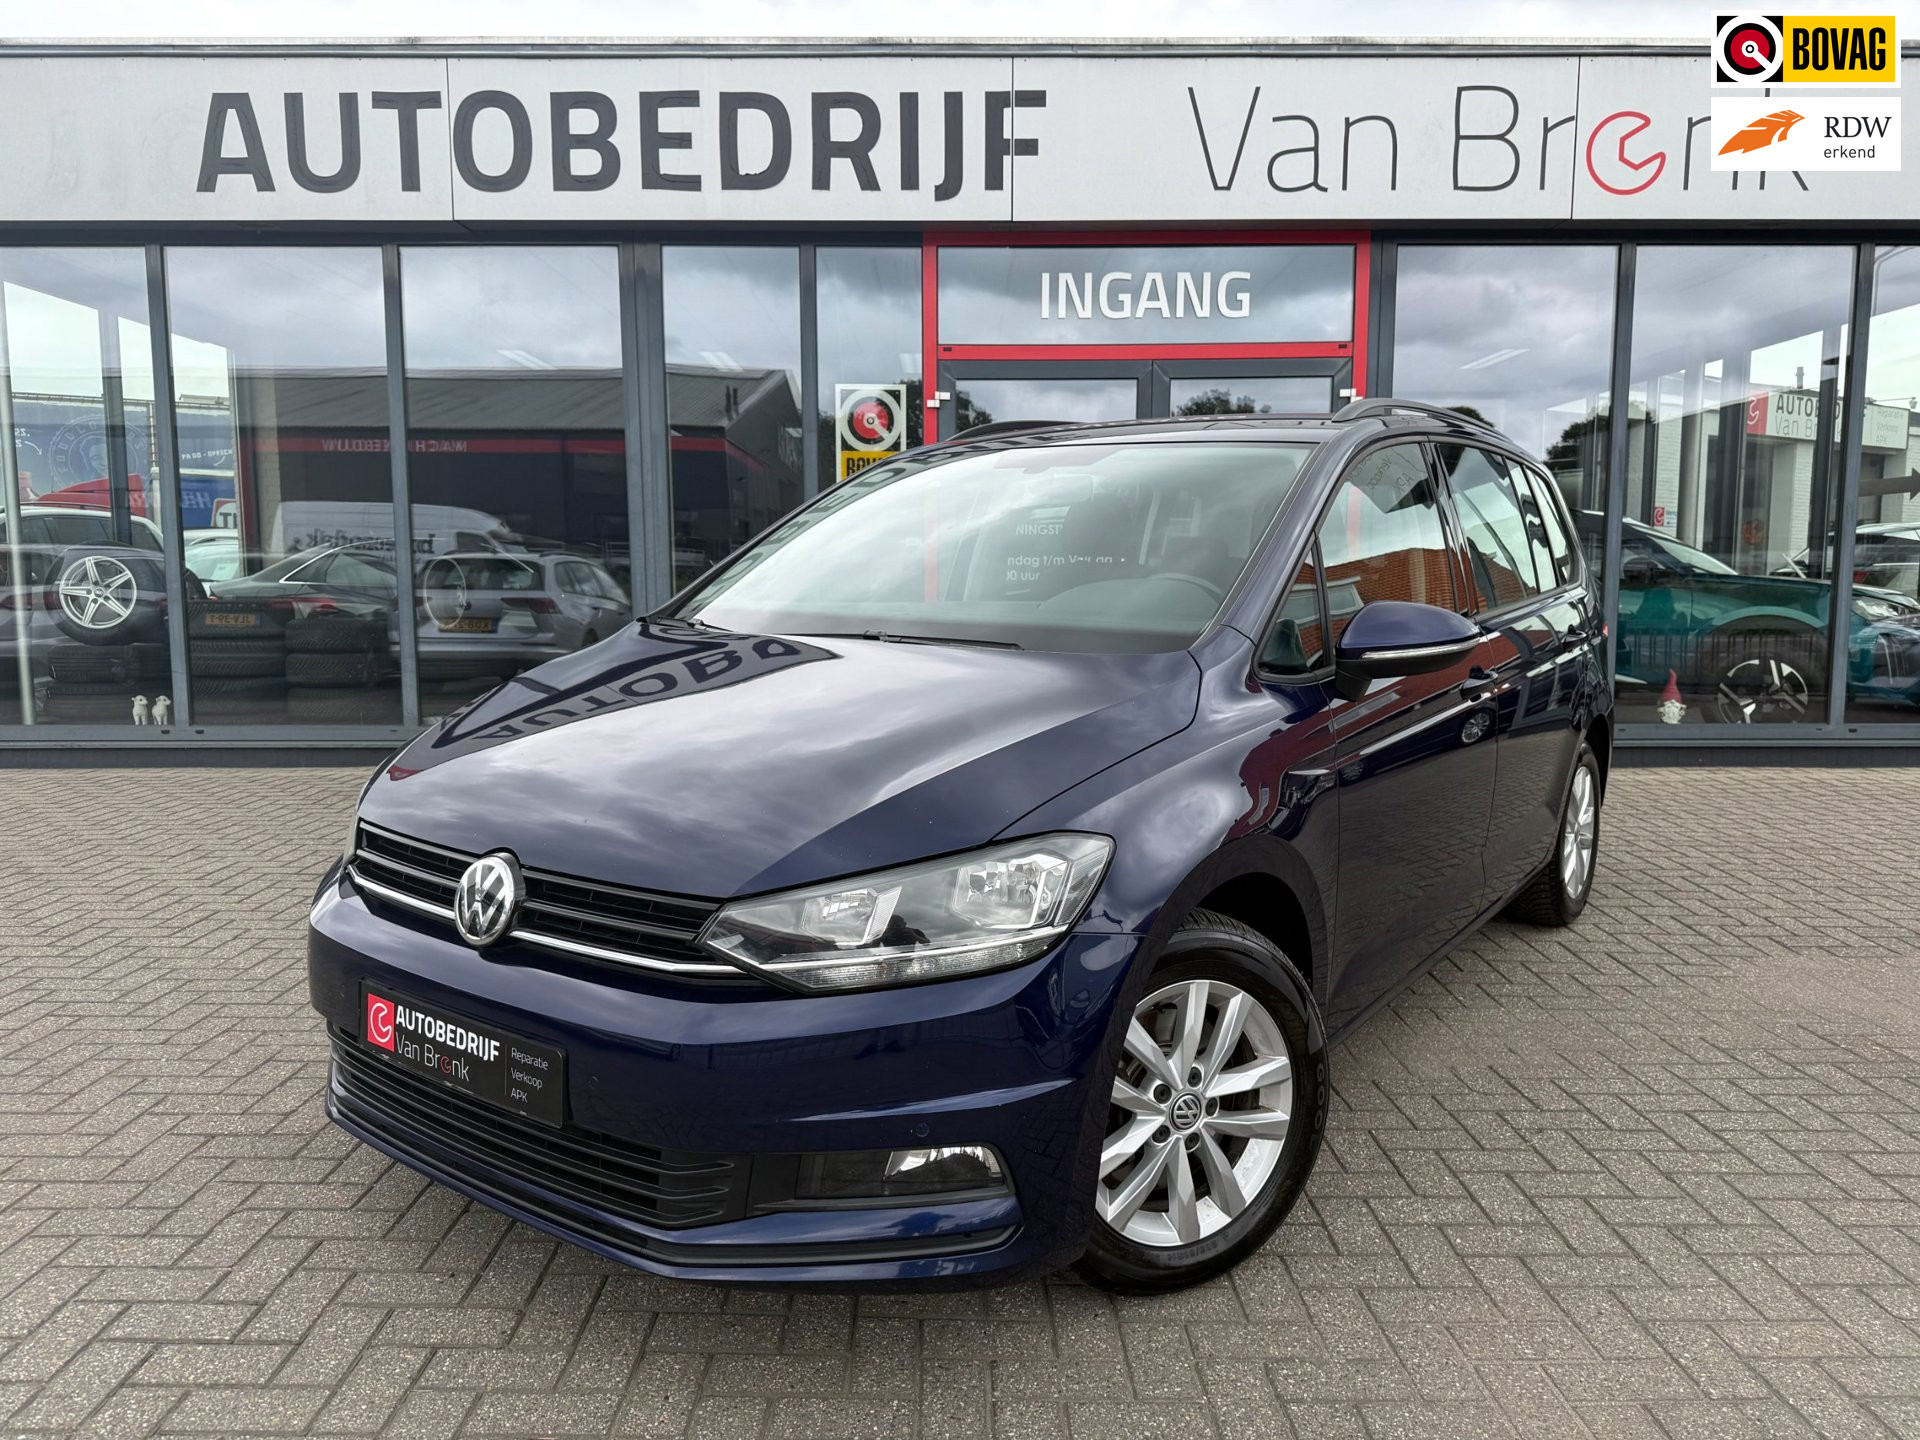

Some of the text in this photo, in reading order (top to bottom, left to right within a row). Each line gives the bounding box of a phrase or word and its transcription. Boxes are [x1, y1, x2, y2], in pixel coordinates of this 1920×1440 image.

[196, 90, 1048, 203] AUTOBEDRIJF
[1187, 86, 1399, 193] Van
[1041, 271, 1252, 319] INGANG
[395, 1005, 500, 1061] AUTOBEDRIJF
[395, 1031, 421, 1062] Van
[511, 1047, 549, 1071] Reparatie
[511, 1067, 543, 1090] Verkoop
[510, 1088, 528, 1103] APK
